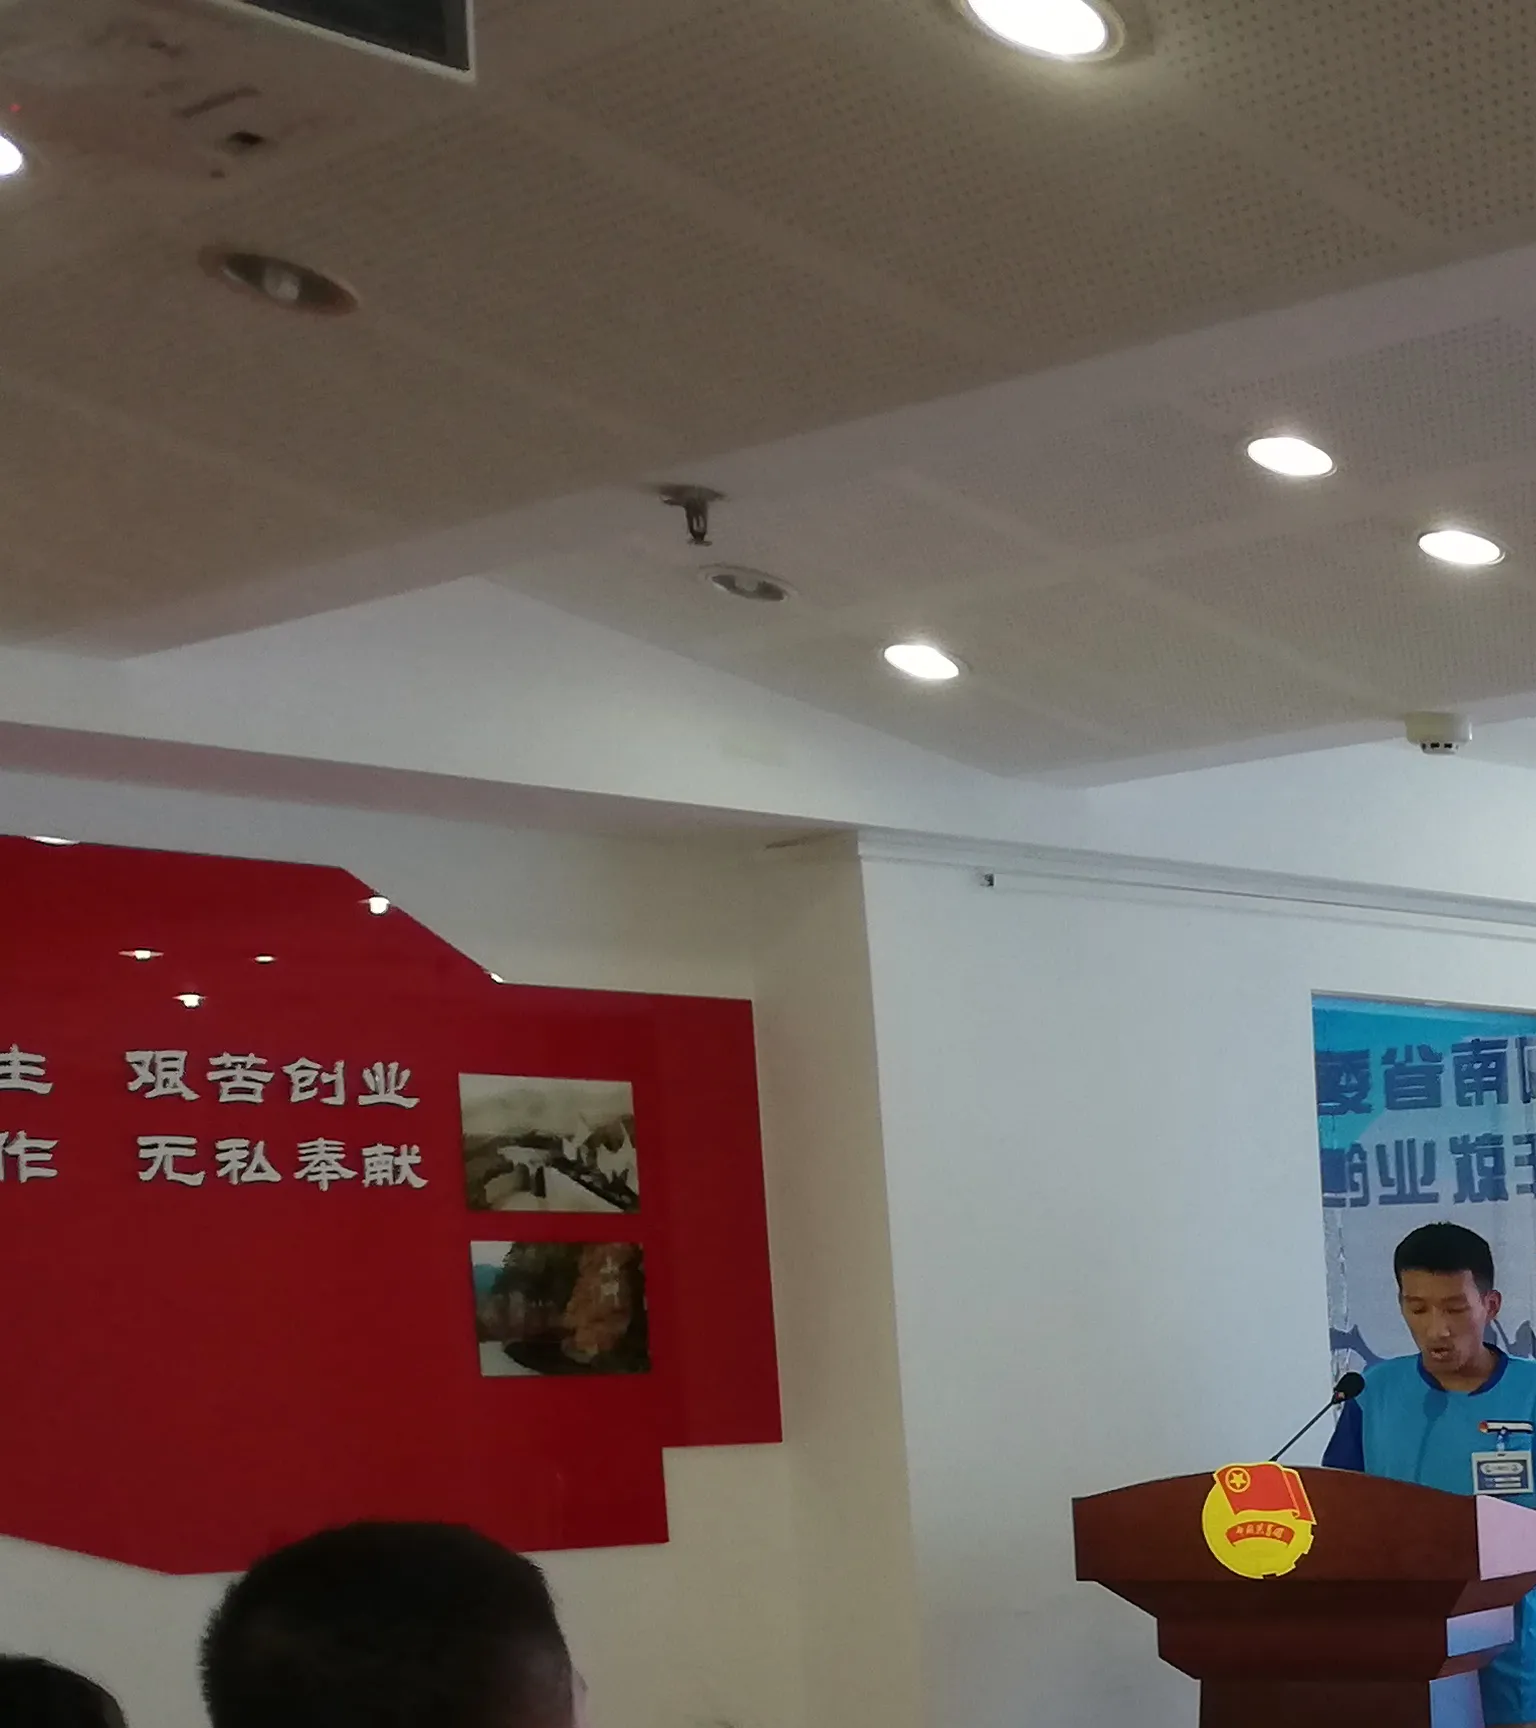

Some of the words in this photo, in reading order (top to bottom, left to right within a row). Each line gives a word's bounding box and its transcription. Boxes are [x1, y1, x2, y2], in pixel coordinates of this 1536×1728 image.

[124, 1050, 421, 1109] 艰苦创业
[0, 1131, 59, 1182] 作
[136, 1135, 430, 1192] 无私奉献
